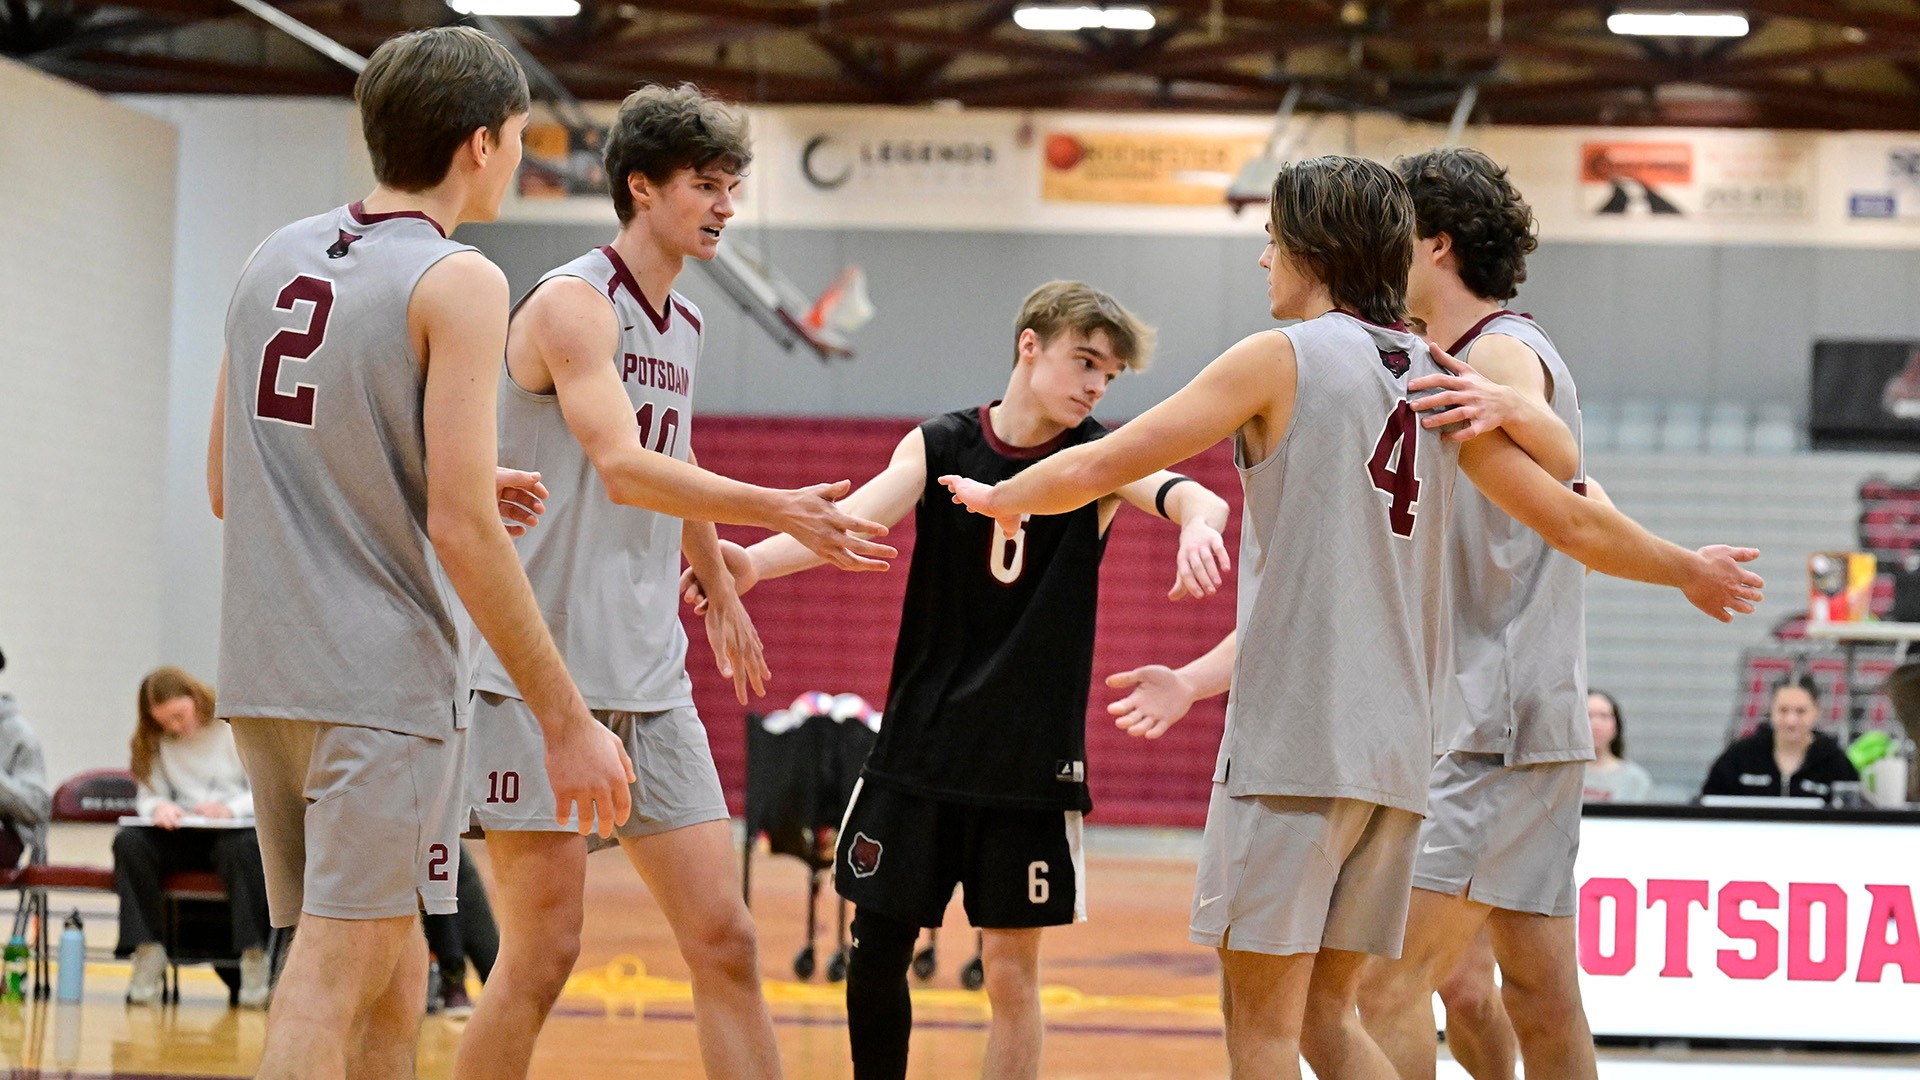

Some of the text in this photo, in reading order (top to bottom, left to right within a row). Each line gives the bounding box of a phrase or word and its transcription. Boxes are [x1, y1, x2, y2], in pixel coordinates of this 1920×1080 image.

[255, 273, 336, 428] 2
[1364, 397, 1422, 540] 4
[486, 770, 520, 803] 10
[428, 843, 449, 882] 2
[1028, 860, 1050, 904] 6
